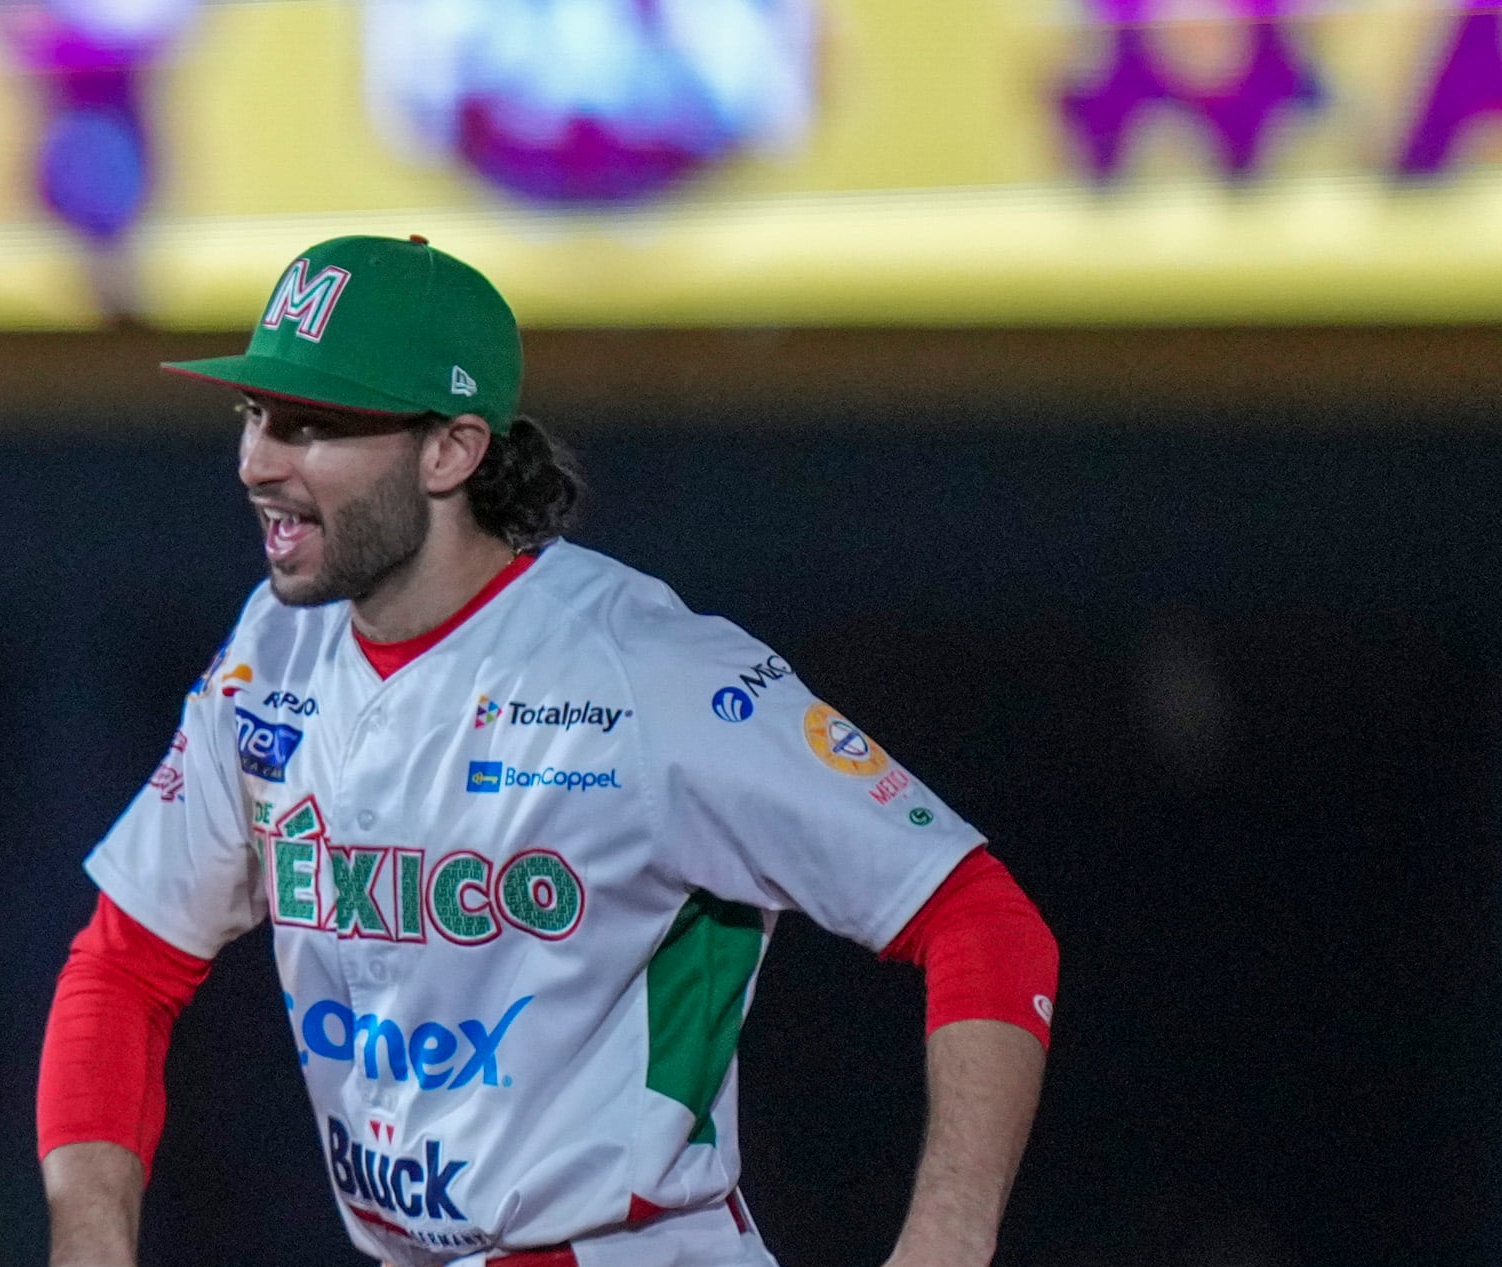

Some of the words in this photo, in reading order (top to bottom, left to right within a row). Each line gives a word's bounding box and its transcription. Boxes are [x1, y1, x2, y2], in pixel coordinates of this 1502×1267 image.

[262, 257, 352, 343] M
[509, 700, 623, 733] Totalplay
[504, 766, 621, 792] BanCoppel
[253, 794, 586, 946] ÉXICO
[284, 992, 535, 1091] omex
